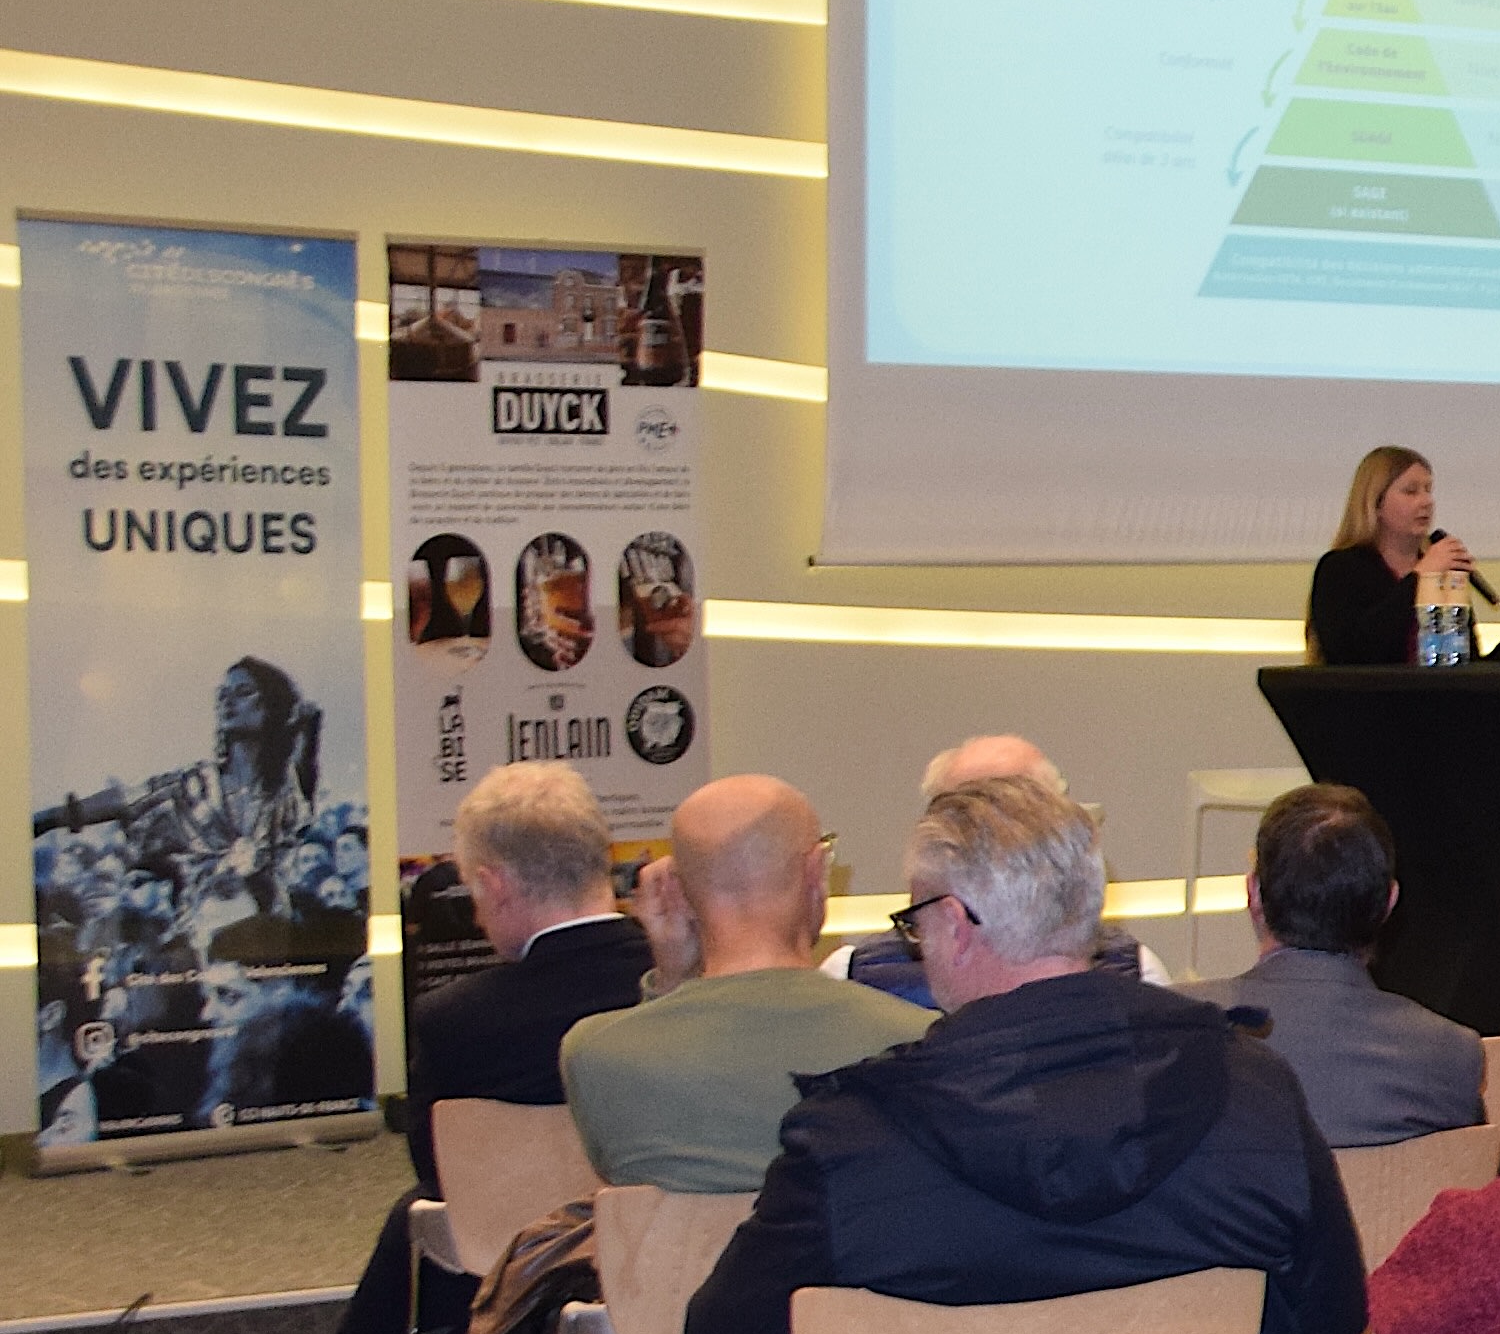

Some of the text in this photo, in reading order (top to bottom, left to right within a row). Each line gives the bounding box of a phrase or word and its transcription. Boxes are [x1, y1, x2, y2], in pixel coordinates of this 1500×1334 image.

[67, 356, 329, 438] VIVEZ
[497, 390, 604, 433] DUYCK
[68, 451, 332, 490] des expériences
[83, 507, 318, 555] UNIQUES
